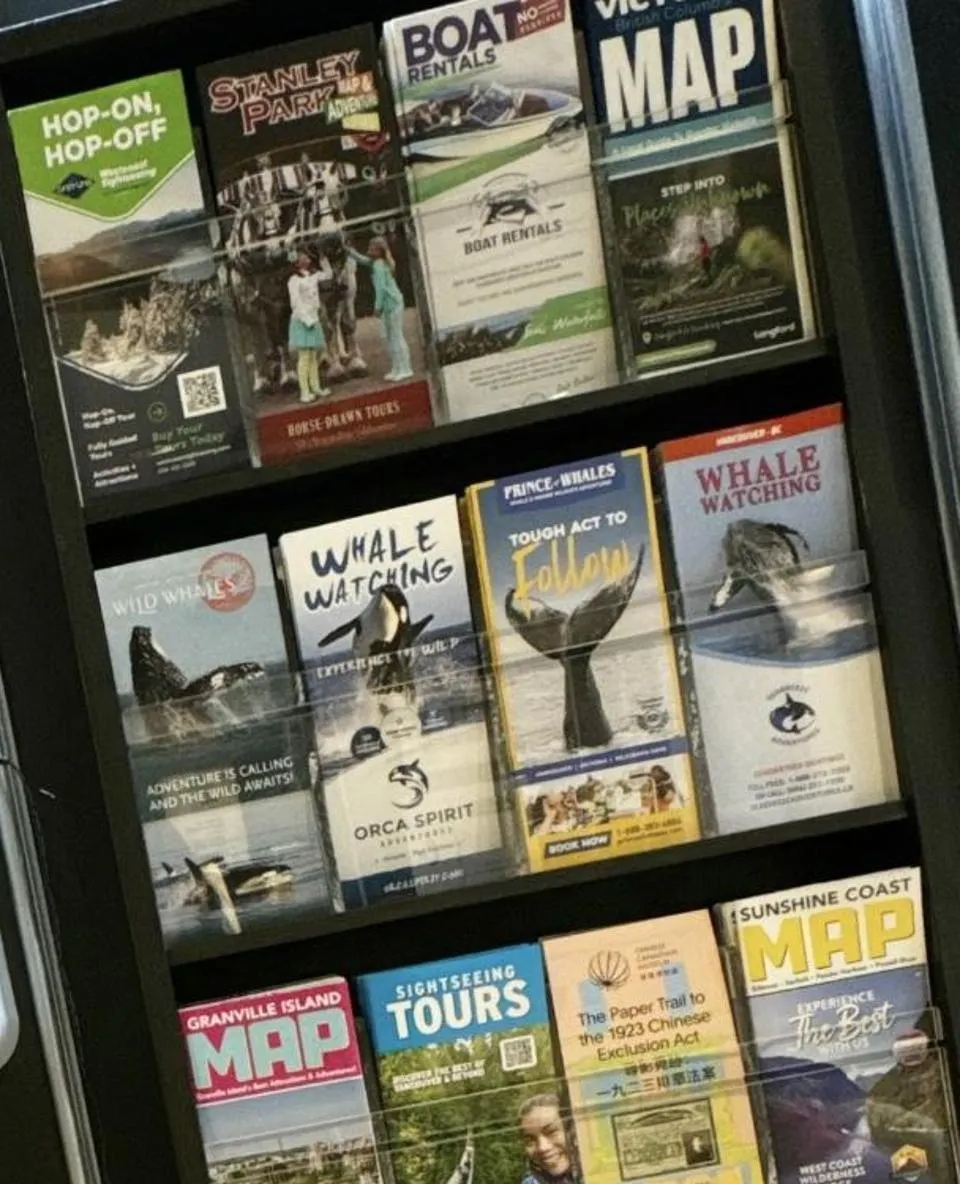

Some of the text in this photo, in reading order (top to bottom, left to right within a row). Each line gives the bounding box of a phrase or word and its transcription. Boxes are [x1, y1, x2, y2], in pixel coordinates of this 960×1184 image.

[402, 1, 520, 67] BOAT
[208, 50, 360, 113] STANLEY
[407, 48, 497, 85] RENTALS
[600, 8, 755, 133] MAP
[42, 91, 162, 138] HOP-ON,
[242, 84, 335, 135] PARK
[44, 118, 167, 168] HOP-OFF
[661, 174, 725, 198] STEP INTO
[464, 219, 562, 256] BOAT RENTALS
[504, 462, 617, 500] PRINCE WHALES
[696, 444, 821, 494] WHALE
[699, 474, 821, 515] WATCHING
[310, 519, 439, 577] WHALE
[508, 510, 628, 547] TOUGH ACT TO
[112, 577, 237, 616] WILD WHALES
[304, 557, 455, 612] WATCHING
[511, 537, 630, 618] Follow
[146, 756, 294, 797] ADVENTURE IS CALLING
[148, 794, 179, 813] AND
[180, 788, 209, 806] THE
[209, 783, 242, 801] WILD
[354, 803, 474, 842] ORCA SPIRIT
[740, 877, 912, 923] SUNSHINE COAST
[743, 897, 915, 983] MAP
[395, 965, 516, 1000] SIGHTSEEING
[187, 991, 342, 1031] GRANVILLE ISLAND
[386, 980, 532, 1039] TOURS
[577, 993, 706, 1027] The Paper Trail to
[579, 1010, 711, 1047] the 1923 Chinese
[833, 1002, 897, 1037] Best
[189, 1007, 350, 1089] MAP
[596, 1031, 701, 1062] Exclusion Act
[799, 1155, 864, 1177] WEST COAST
